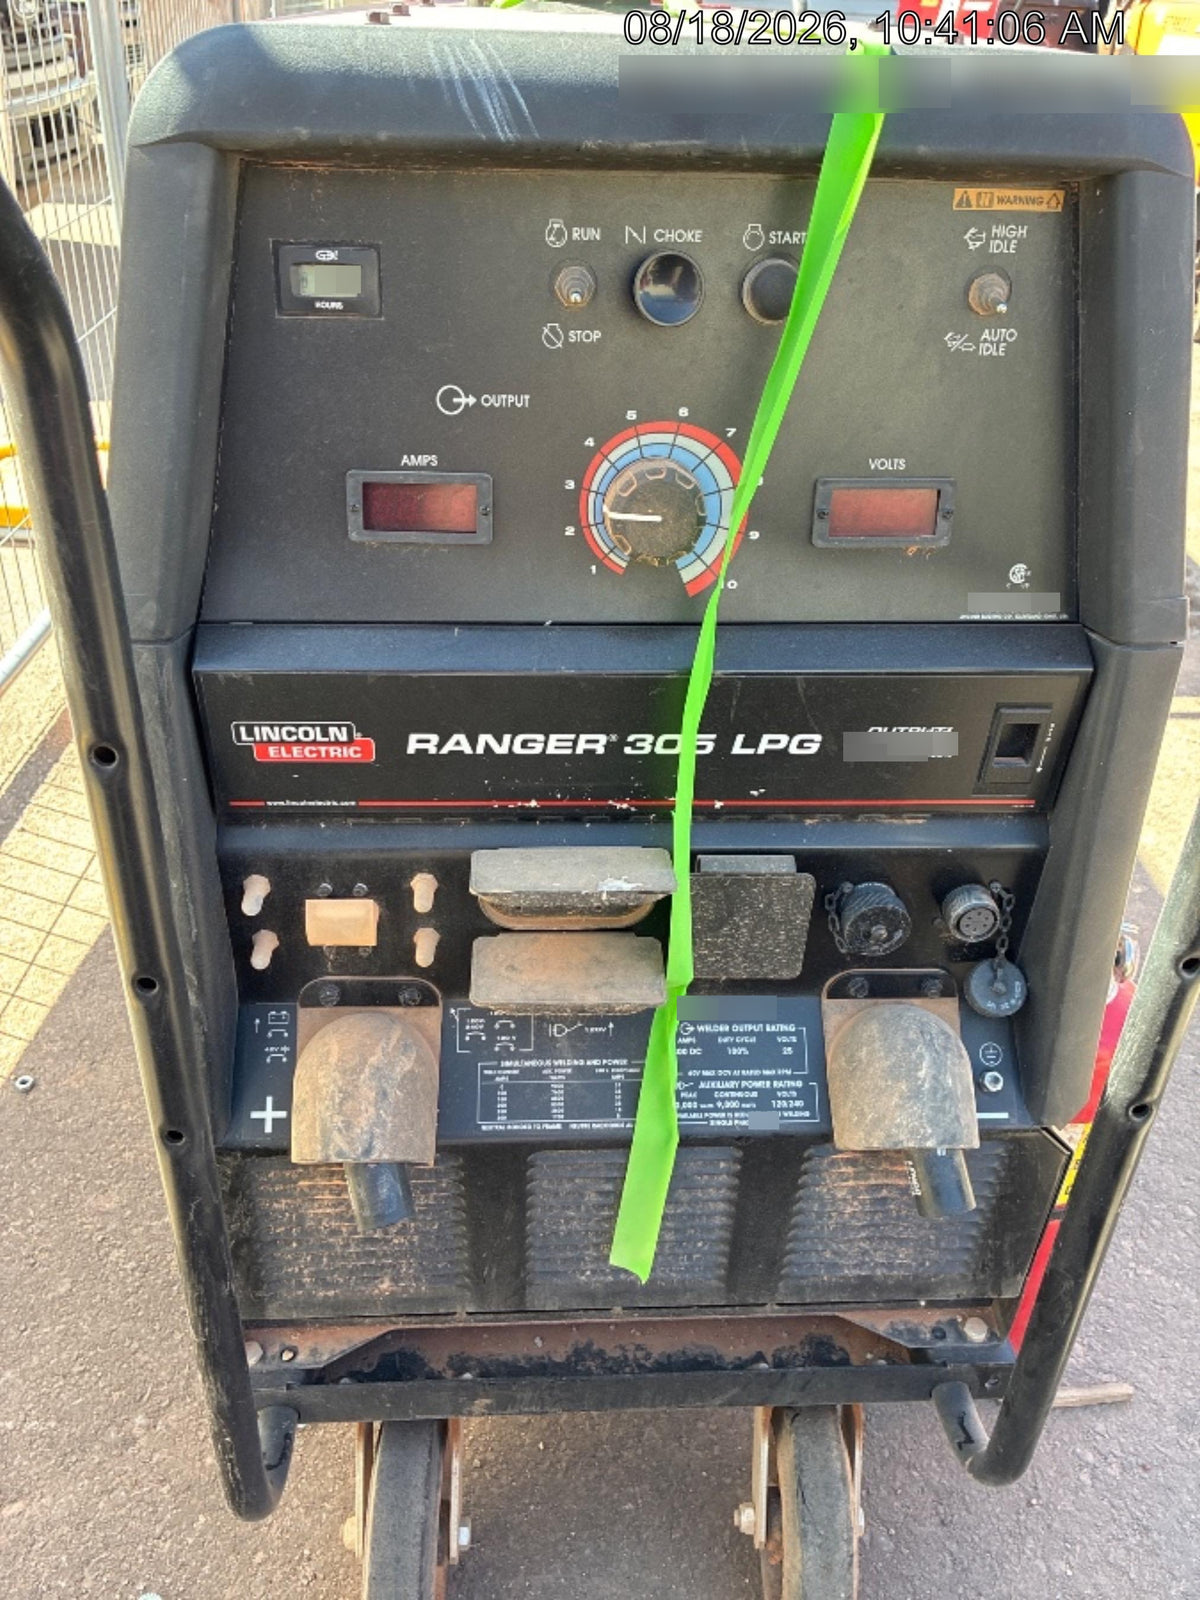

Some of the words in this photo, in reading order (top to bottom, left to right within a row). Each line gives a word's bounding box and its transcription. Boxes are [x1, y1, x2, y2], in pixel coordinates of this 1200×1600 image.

[996, 195, 1045, 206] WARNING
[571, 226, 601, 242] RUN
[653, 228, 703, 243] CHOKE
[769, 230, 807, 245] START
[991, 224, 1029, 239] HIGH
[988, 239, 1018, 253] IDLE
[568, 330, 602, 344] STOP
[980, 328, 1018, 342] AUTO
[978, 342, 1008, 356] IDLE
[480, 393, 530, 408] OUTPUT
[625, 410, 638, 421] 5
[678, 406, 689, 417] 6
[725, 427, 737, 438] 7
[584, 437, 595, 447] 4
[400, 454, 439, 467] AMPS
[868, 457, 907, 471] VOLTS
[564, 479, 576, 491] 3
[564, 526, 576, 537] 2
[748, 530, 760, 541] 9
[590, 564, 597, 575] 1
[239, 725, 349, 742] LINCOLN
[623, 733, 718, 755] 305
[730, 733, 823, 755] LPG
[267, 745, 363, 758] ELECTRIC
[696, 1023, 730, 1033] WELDER
[731, 1023, 764, 1033] OUTPUT
[765, 1022, 796, 1032] RATING
[741, 1080, 771, 1089] POWER
[773, 1080, 803, 1088] RATING
